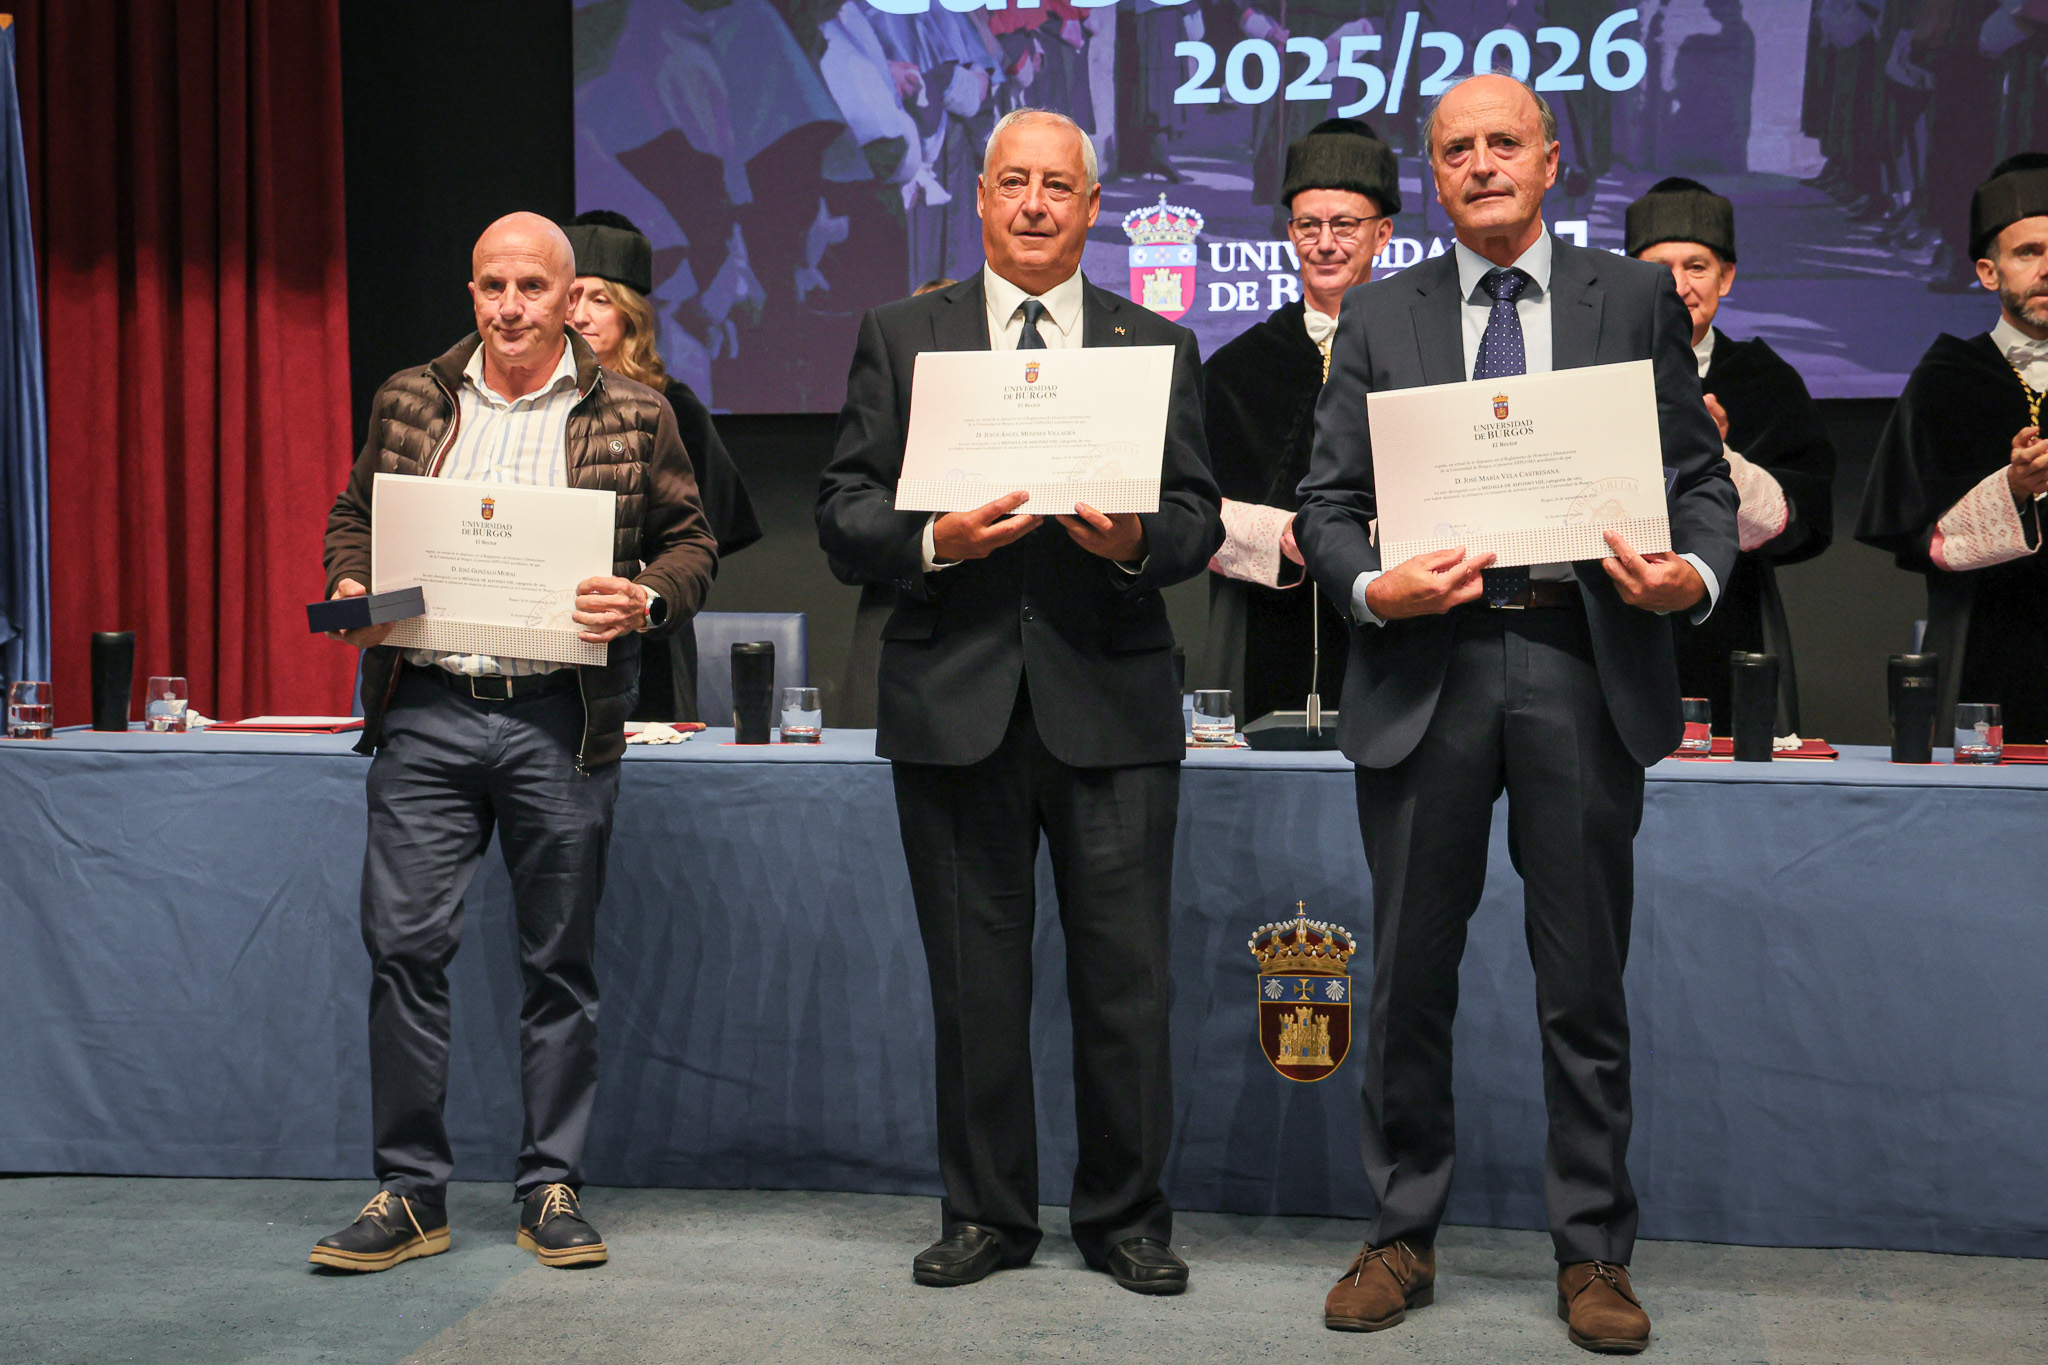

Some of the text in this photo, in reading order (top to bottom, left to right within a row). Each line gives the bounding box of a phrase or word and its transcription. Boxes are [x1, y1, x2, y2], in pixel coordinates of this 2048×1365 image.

[1174, 9, 1647, 118] 2025/2026
[1208, 281, 1260, 312] DE
[1016, 392, 1057, 400] BURGOS
[1473, 419, 1534, 432] UNIVERSIDAD
[1475, 427, 1534, 441] DE BURGOS
[1463, 476, 1478, 484] JOSÉ
[1479, 474, 1500, 482] MARÍA
[1501, 472, 1518, 480] VELA
[1519, 468, 1560, 478] CASTRESANA
[462, 521, 513, 531] UNIVERSIDAD
[473, 528, 512, 539] BURGOS
[471, 568, 497, 576] GONZALO
